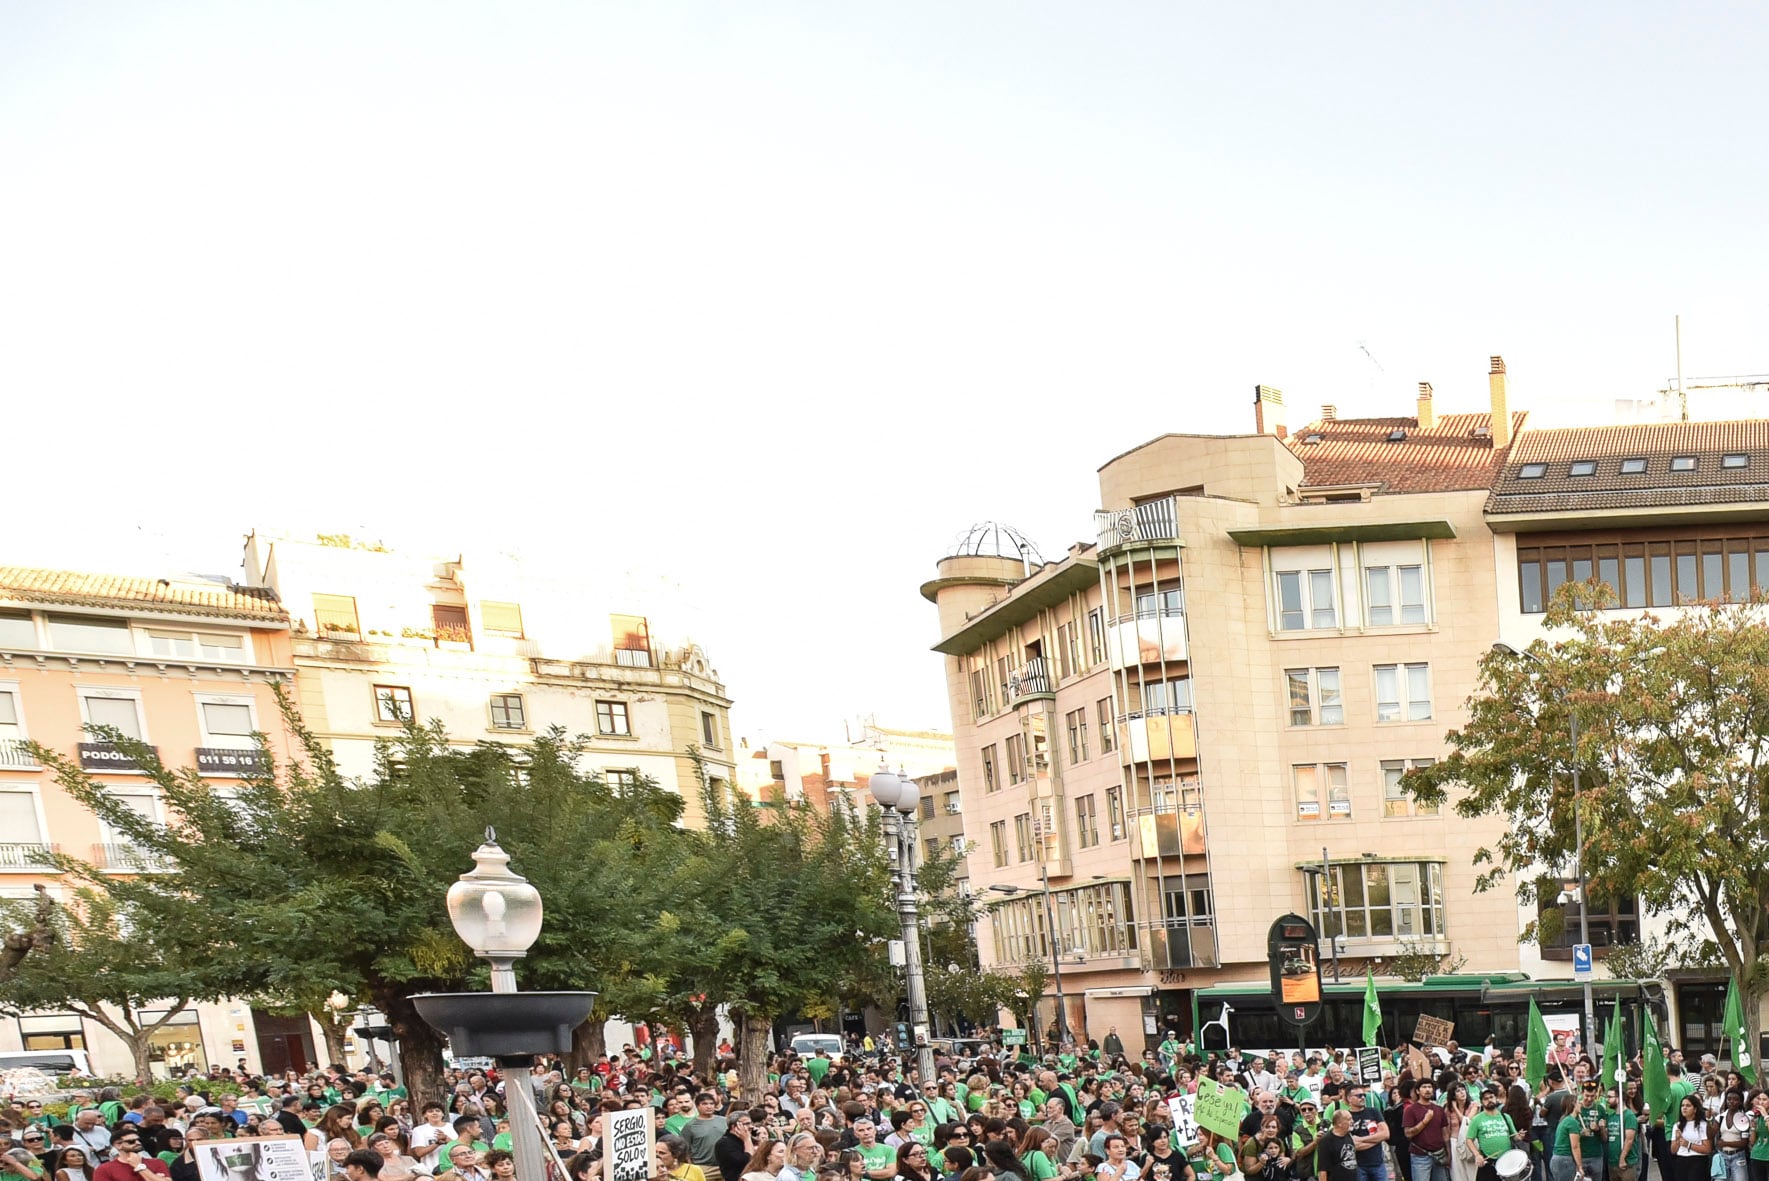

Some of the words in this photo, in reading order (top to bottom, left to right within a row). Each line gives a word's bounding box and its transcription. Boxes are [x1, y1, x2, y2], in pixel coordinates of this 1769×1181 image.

[82, 750, 154, 760] PODÓL
[200, 755, 219, 764] 611
[222, 756, 236, 764] 59
[239, 756, 253, 765] 16
[613, 1115, 646, 1138] SERGIO,
[615, 1136, 626, 1152] NO
[617, 1147, 640, 1165] SOLO
